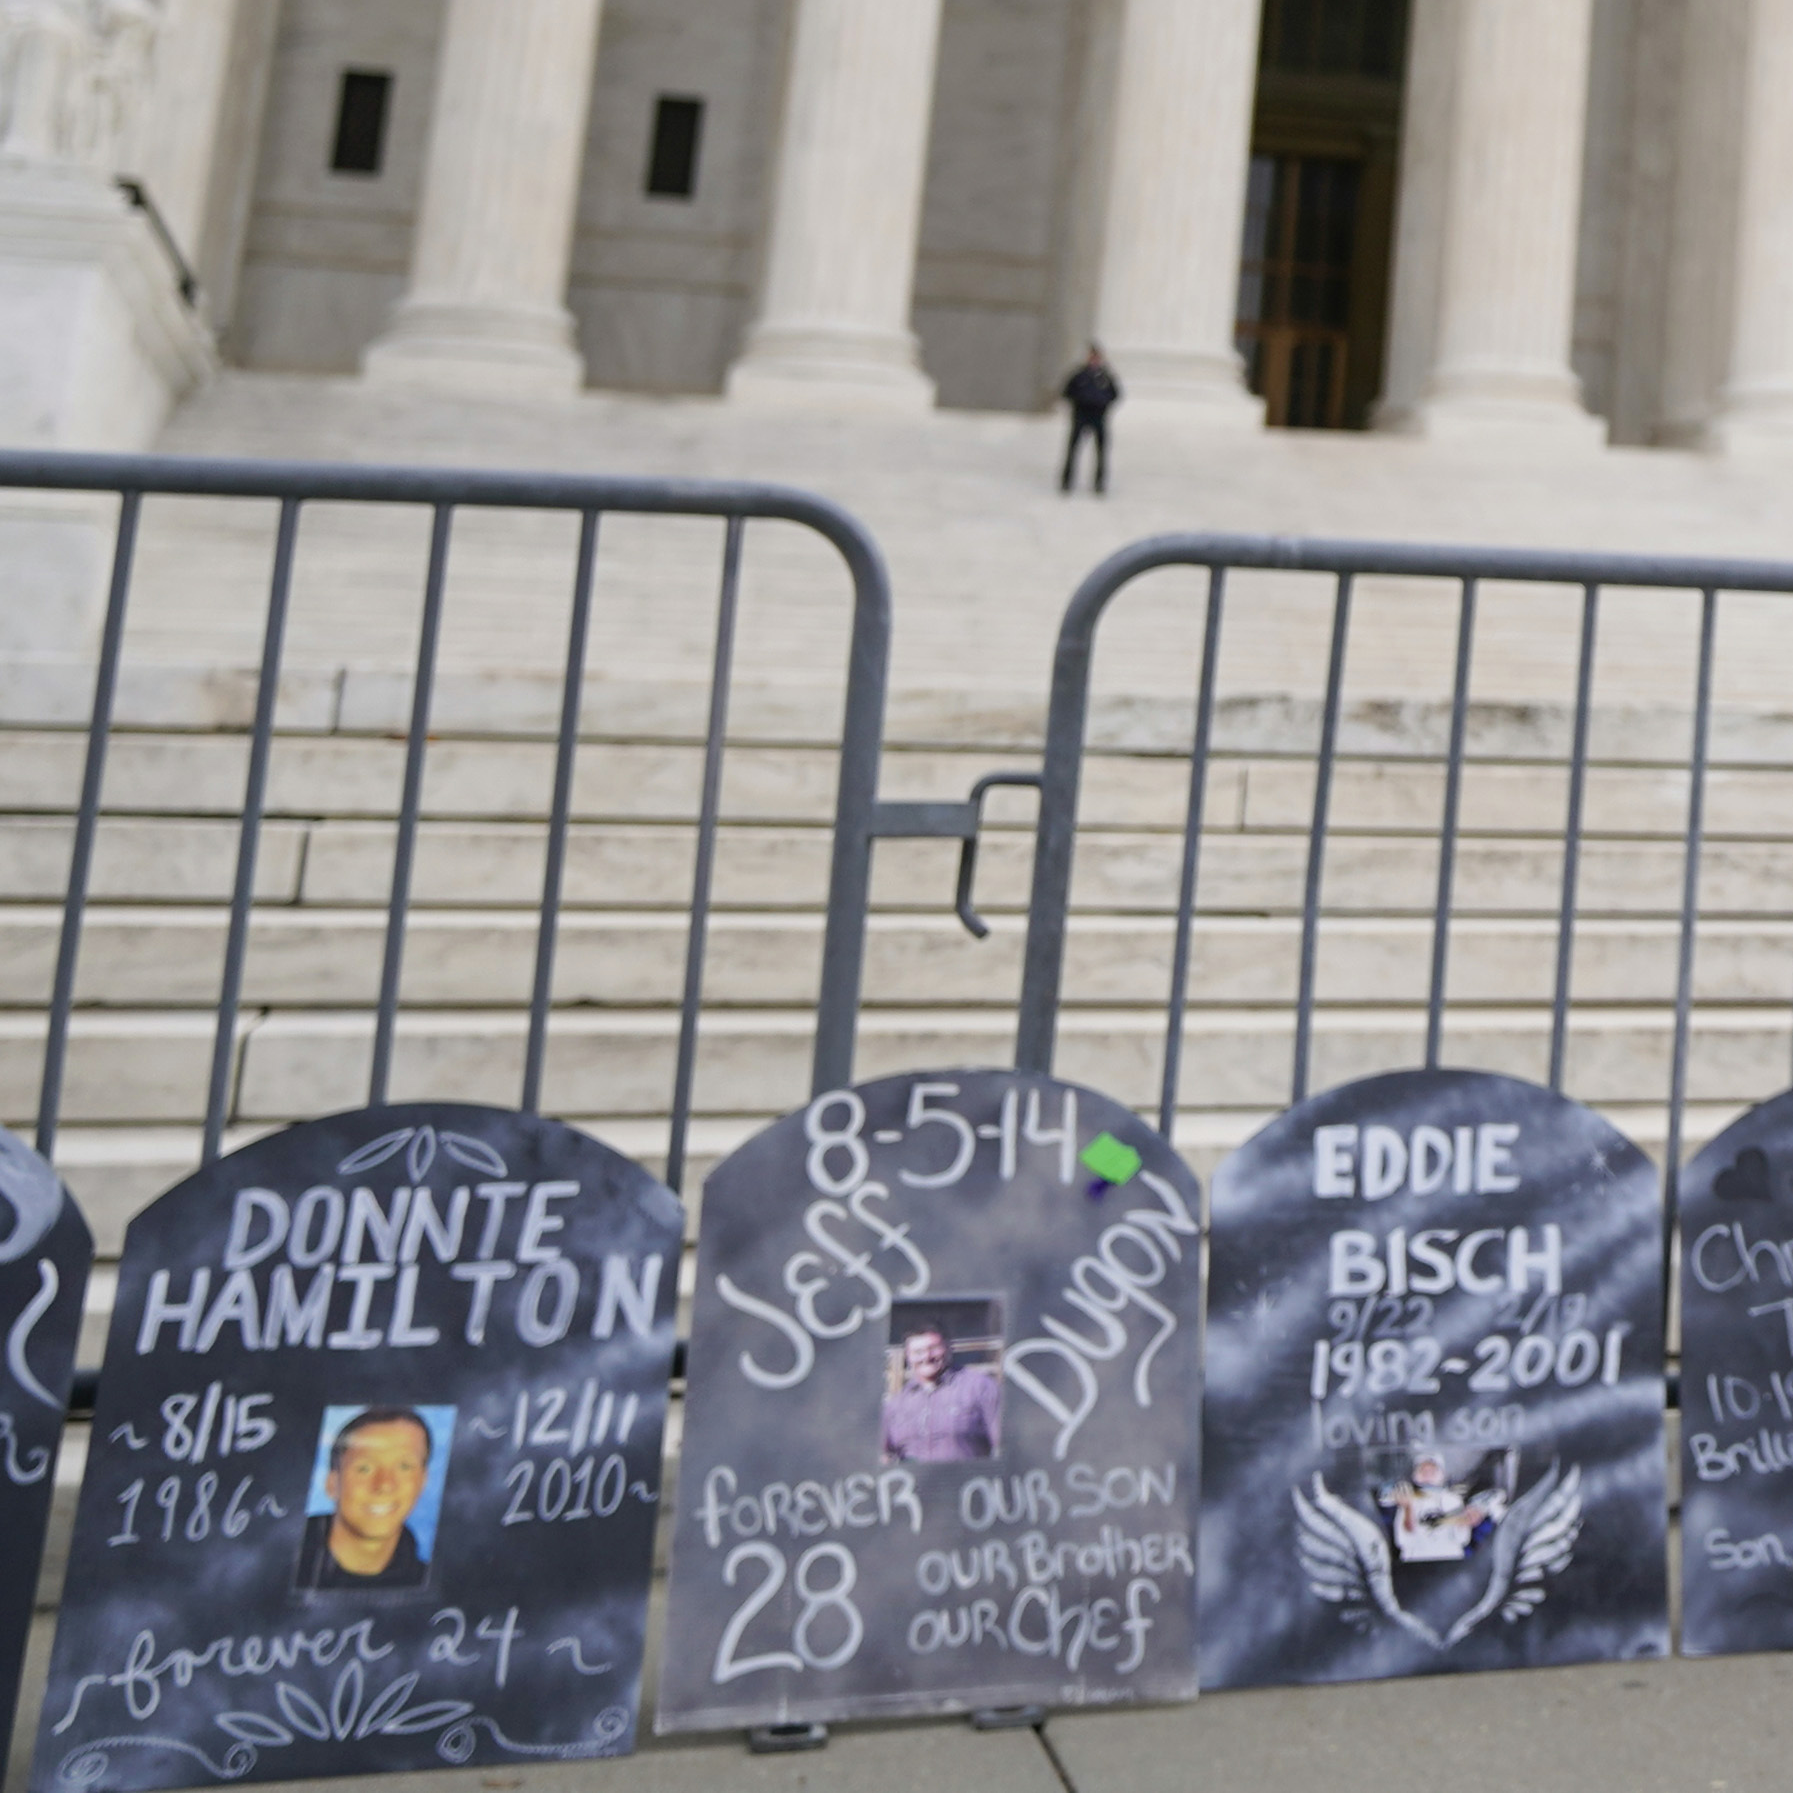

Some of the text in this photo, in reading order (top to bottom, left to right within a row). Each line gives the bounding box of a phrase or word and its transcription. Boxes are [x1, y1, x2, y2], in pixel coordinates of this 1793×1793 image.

[805, 1082, 1078, 1196] 8-5-14
[1312, 1123, 1521, 1202] EDDIE
[222, 1180, 581, 1270] DONNIE
[1327, 1224, 1562, 1298] BISCH
[136, 1253, 664, 1354] HAMILTON
[108, 1605, 525, 1719] forever 24
[712, 1540, 865, 1684] 28
